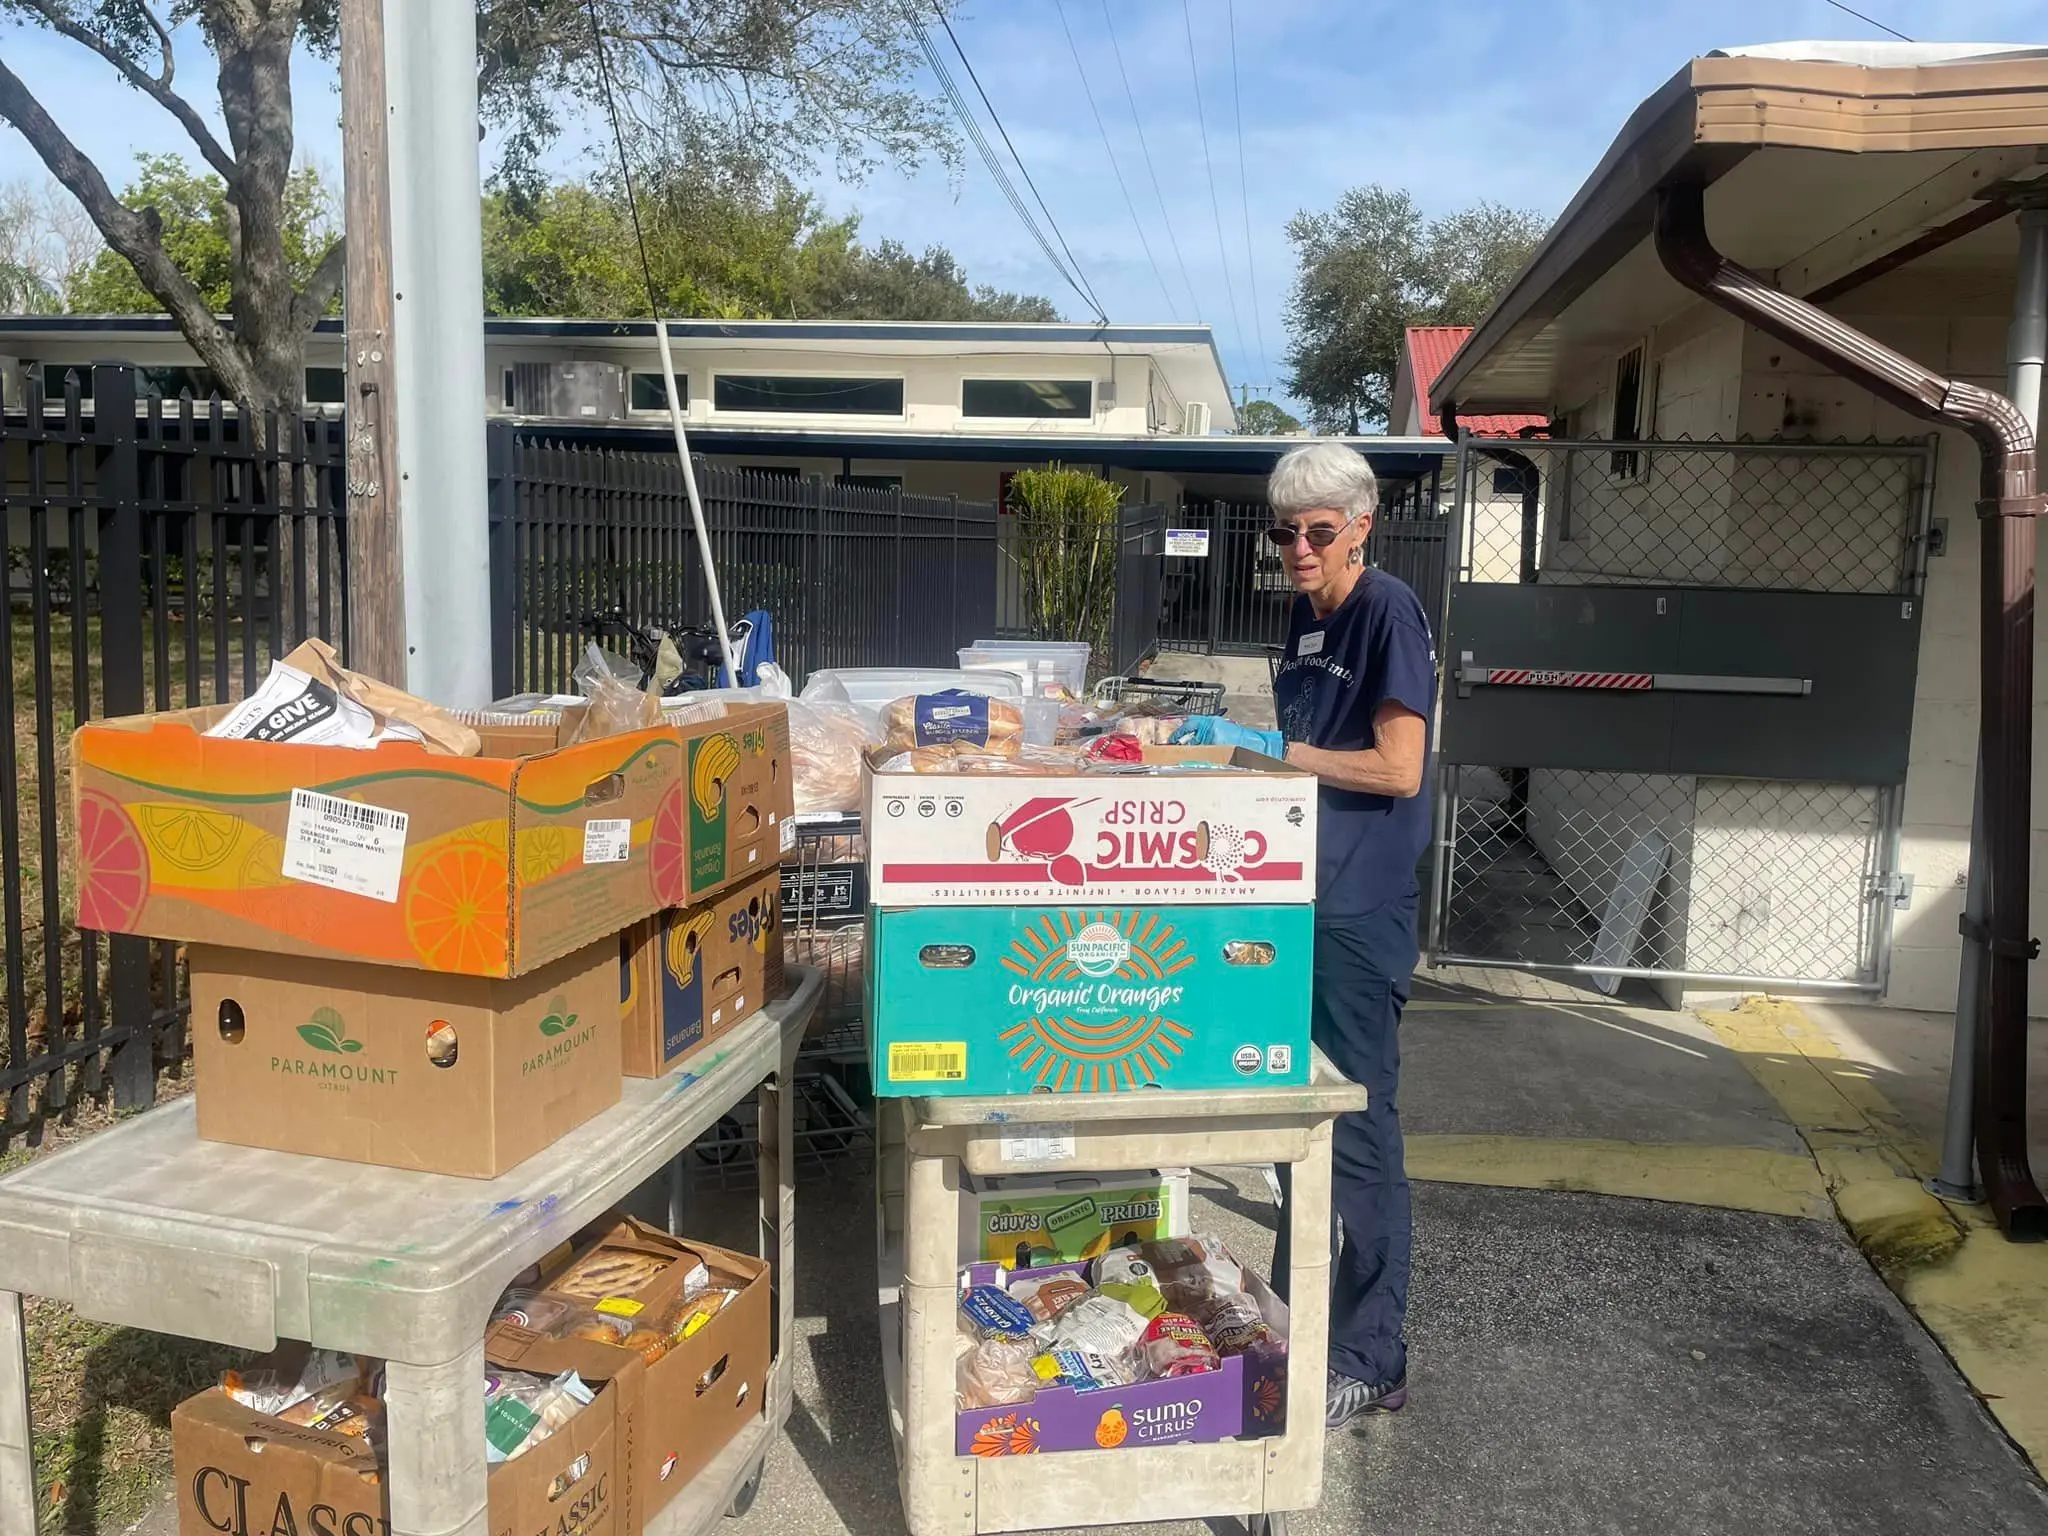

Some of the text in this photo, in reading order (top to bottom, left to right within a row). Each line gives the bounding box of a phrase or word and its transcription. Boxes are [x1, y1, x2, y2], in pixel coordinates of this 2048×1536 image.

[1529, 673, 1558, 681] PUSH
[269, 693, 320, 729] GIVE
[1105, 800, 1186, 825] CRISP
[1098, 830, 1268, 866] COSMIC
[1048, 888, 1111, 896] INFINITE
[1135, 888, 1184, 896] FLAVOR
[1195, 887, 1256, 895] AMAZING
[1071, 943, 1126, 952] SUN PACIFIC
[1008, 982, 1184, 1014] Organic Oranges
[666, 1020, 701, 1050] Bananas
[522, 1025, 597, 1076] PARAMOUNT
[270, 1055, 398, 1086] PARAMOUNT
[318, 1082, 351, 1093] CITRUS
[988, 1214, 1041, 1232] CHUY'S
[1051, 1202, 1090, 1226] ORGANIC
[1101, 1201, 1161, 1224] PRIDE
[1138, 1418, 1195, 1438] CITRUS
